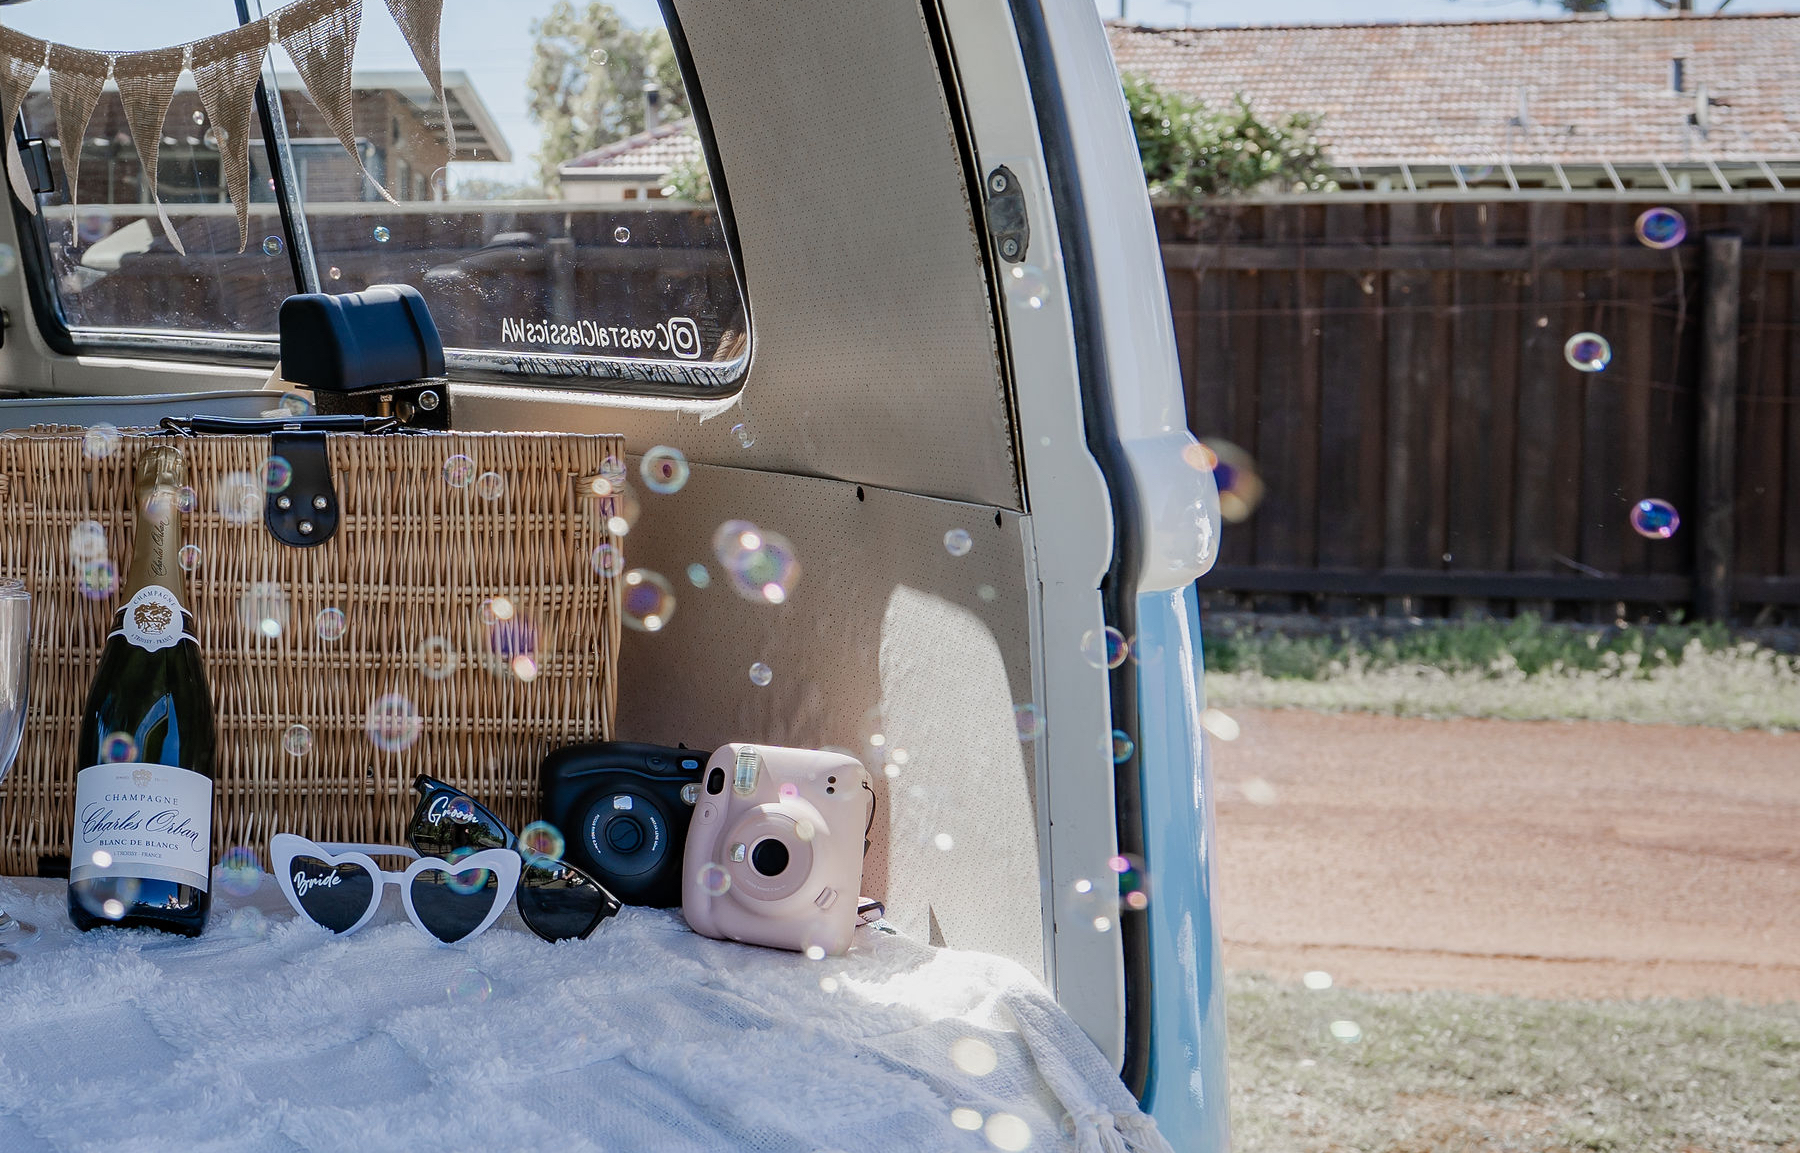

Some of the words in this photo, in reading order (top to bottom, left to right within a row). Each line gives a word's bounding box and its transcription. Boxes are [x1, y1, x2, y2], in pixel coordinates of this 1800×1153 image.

[133, 590, 176, 605] CHAMPAGNE
[105, 794, 178, 806] CHAMPAGNE
[428, 796, 479, 827] Groom
[81, 801, 143, 843] Charles
[145, 809, 205, 852] Orban
[145, 841, 179, 850] BLANCS
[294, 869, 342, 897] Bride
